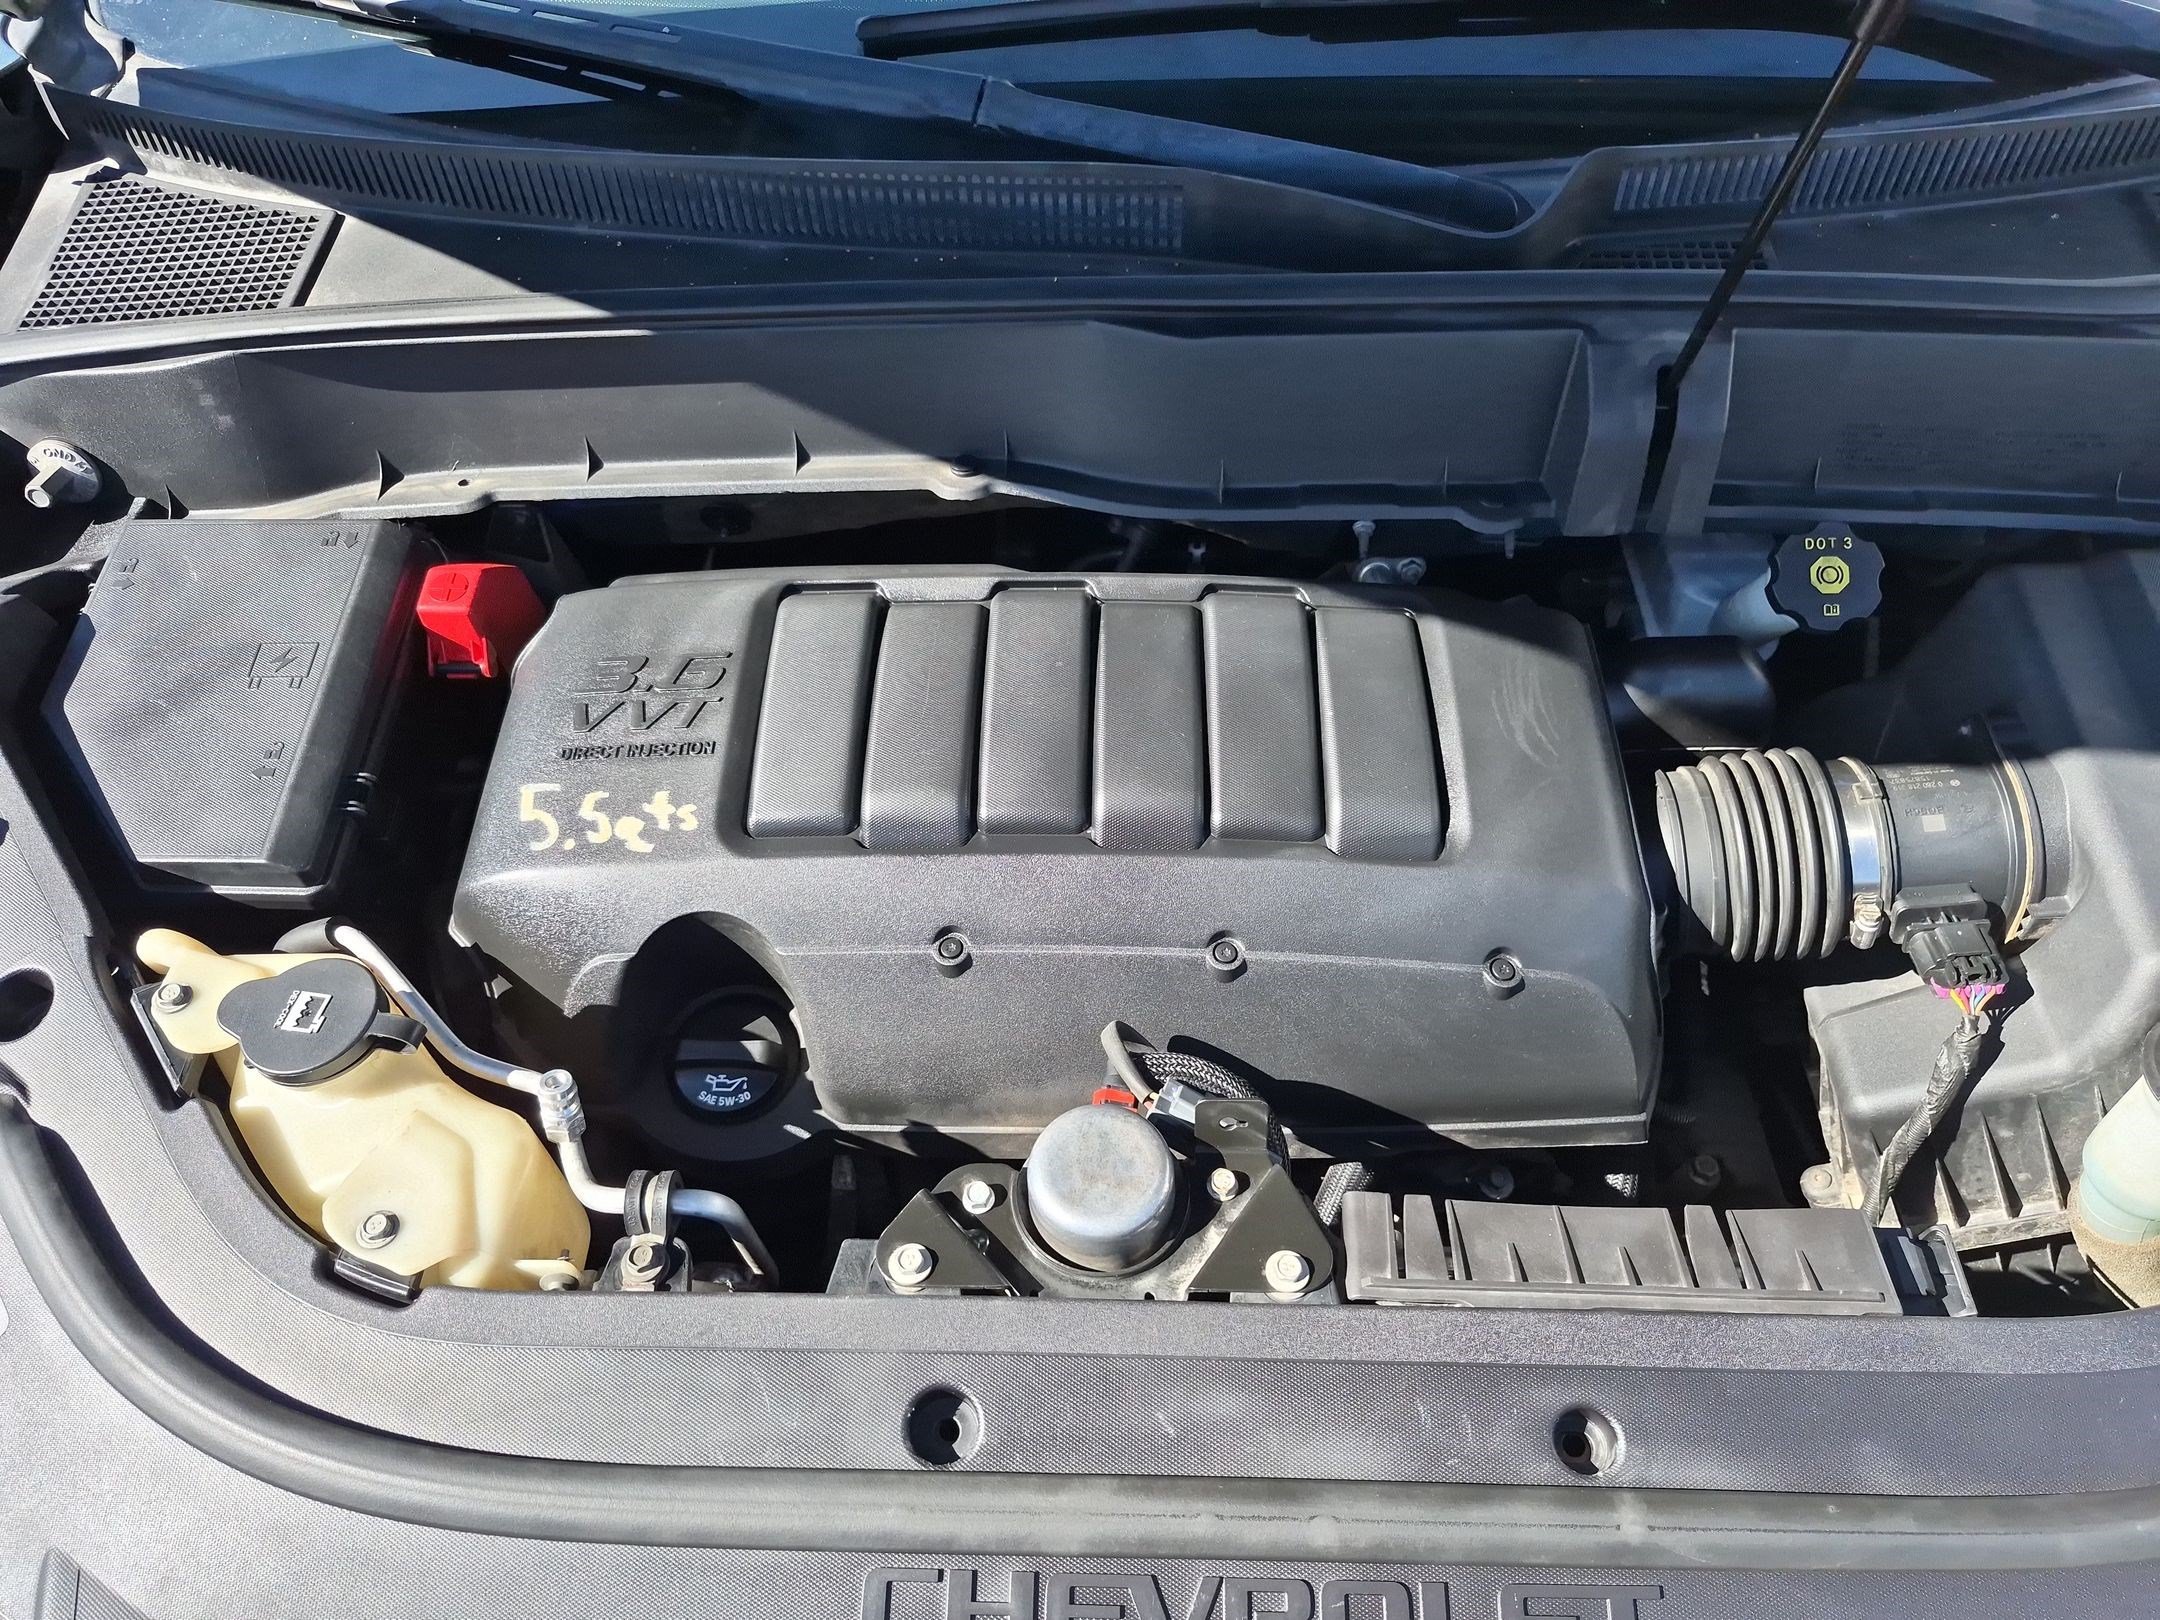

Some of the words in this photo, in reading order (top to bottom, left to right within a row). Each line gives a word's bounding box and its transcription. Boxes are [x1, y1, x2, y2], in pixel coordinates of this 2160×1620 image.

[1805, 537, 1837, 550] DOT
[1843, 537, 1853, 549] 3
[572, 653, 734, 697] 3.6
[572, 697, 725, 734] VVT
[561, 745, 624, 760] DIRECT
[626, 740, 717, 758] INJECTION
[273, 990, 300, 1029] DEX-COOL
[698, 1090, 718, 1105] SAE
[718, 1090, 752, 1106] 5W-30
